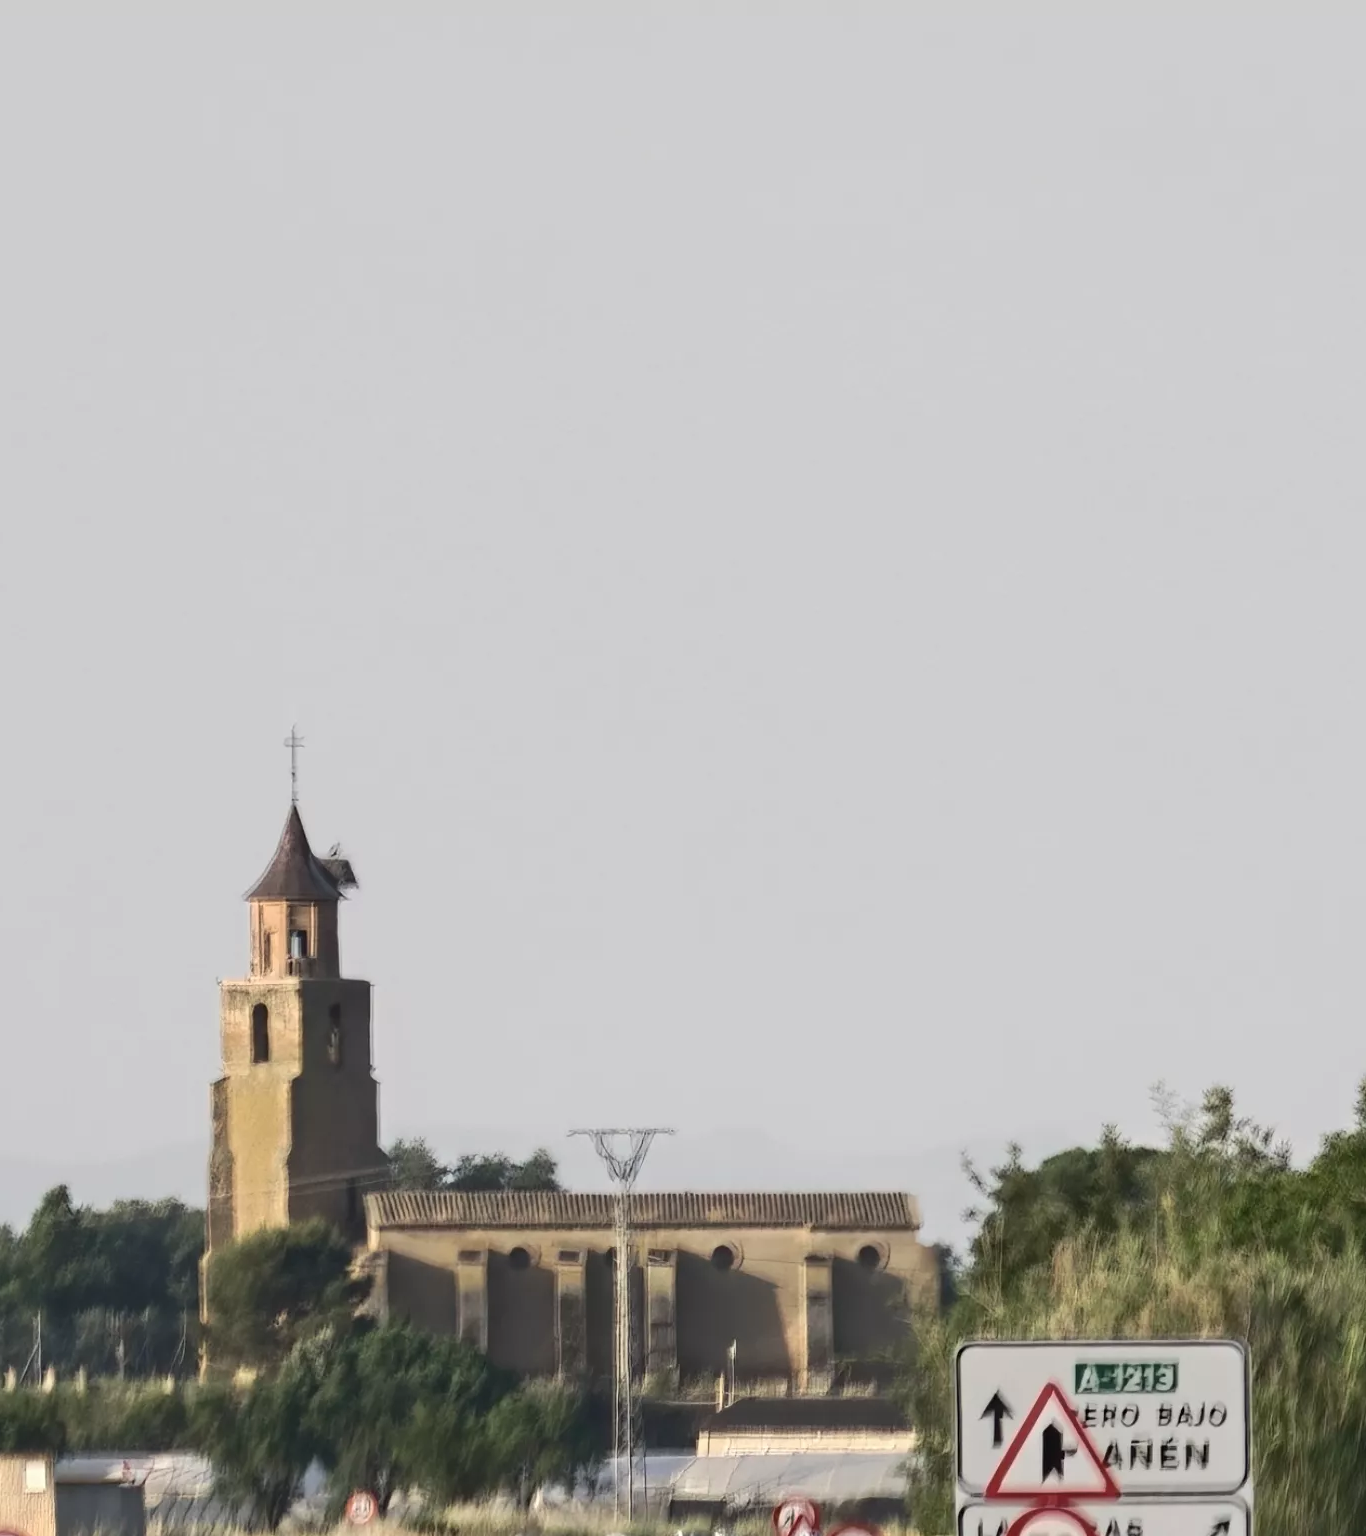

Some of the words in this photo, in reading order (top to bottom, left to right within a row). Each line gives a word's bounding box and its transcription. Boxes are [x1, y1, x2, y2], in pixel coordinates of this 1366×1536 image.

[1082, 1402, 1140, 1427] ERO
[1158, 1402, 1227, 1427] BAJO
[1102, 1436, 1209, 1470] AÑÉN
